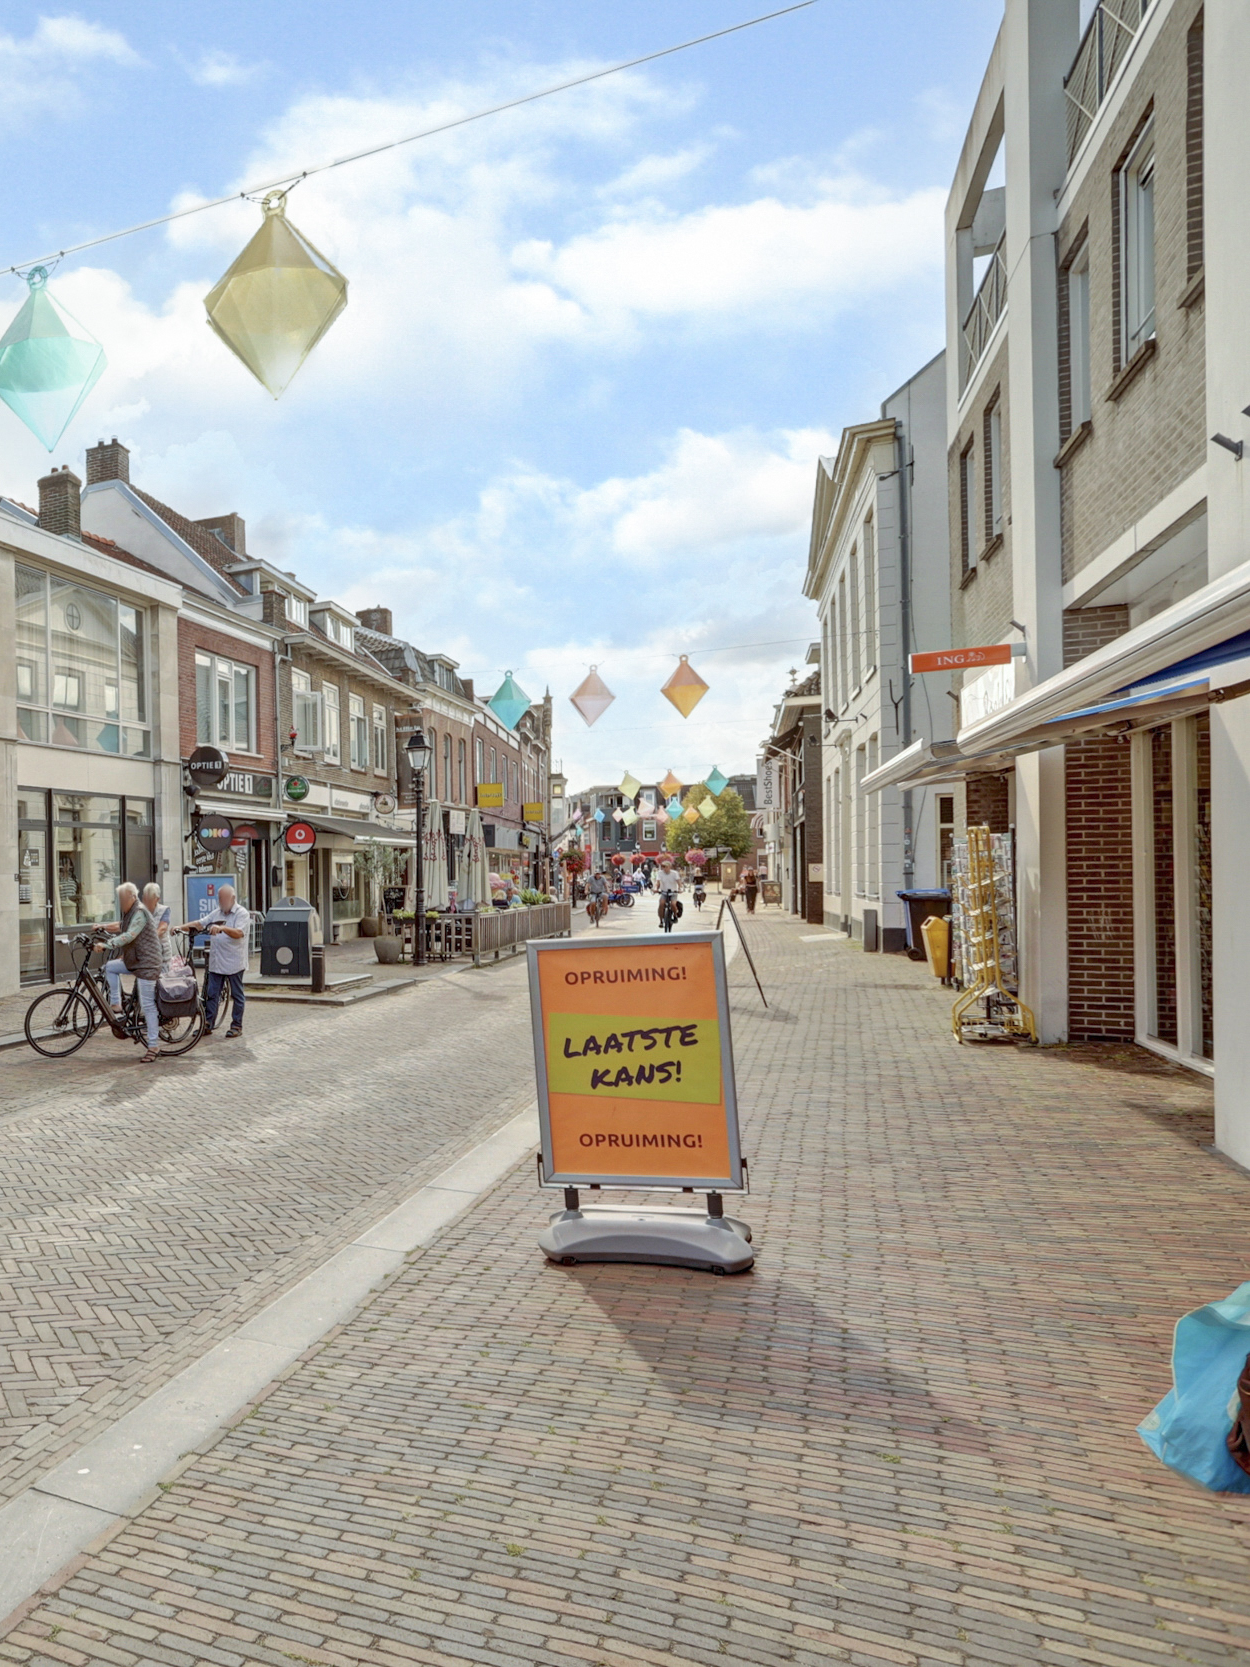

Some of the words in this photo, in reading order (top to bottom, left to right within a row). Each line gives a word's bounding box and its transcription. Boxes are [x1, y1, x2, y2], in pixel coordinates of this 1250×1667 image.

[936, 654, 965, 666] ING
[763, 761, 773, 805] BestShoes
[565, 966, 687, 985] OPRUIMING!
[563, 1024, 699, 1059] LAATSTE
[590, 1060, 682, 1089] KANS!
[579, 1133, 703, 1149] OPRUIMING!
